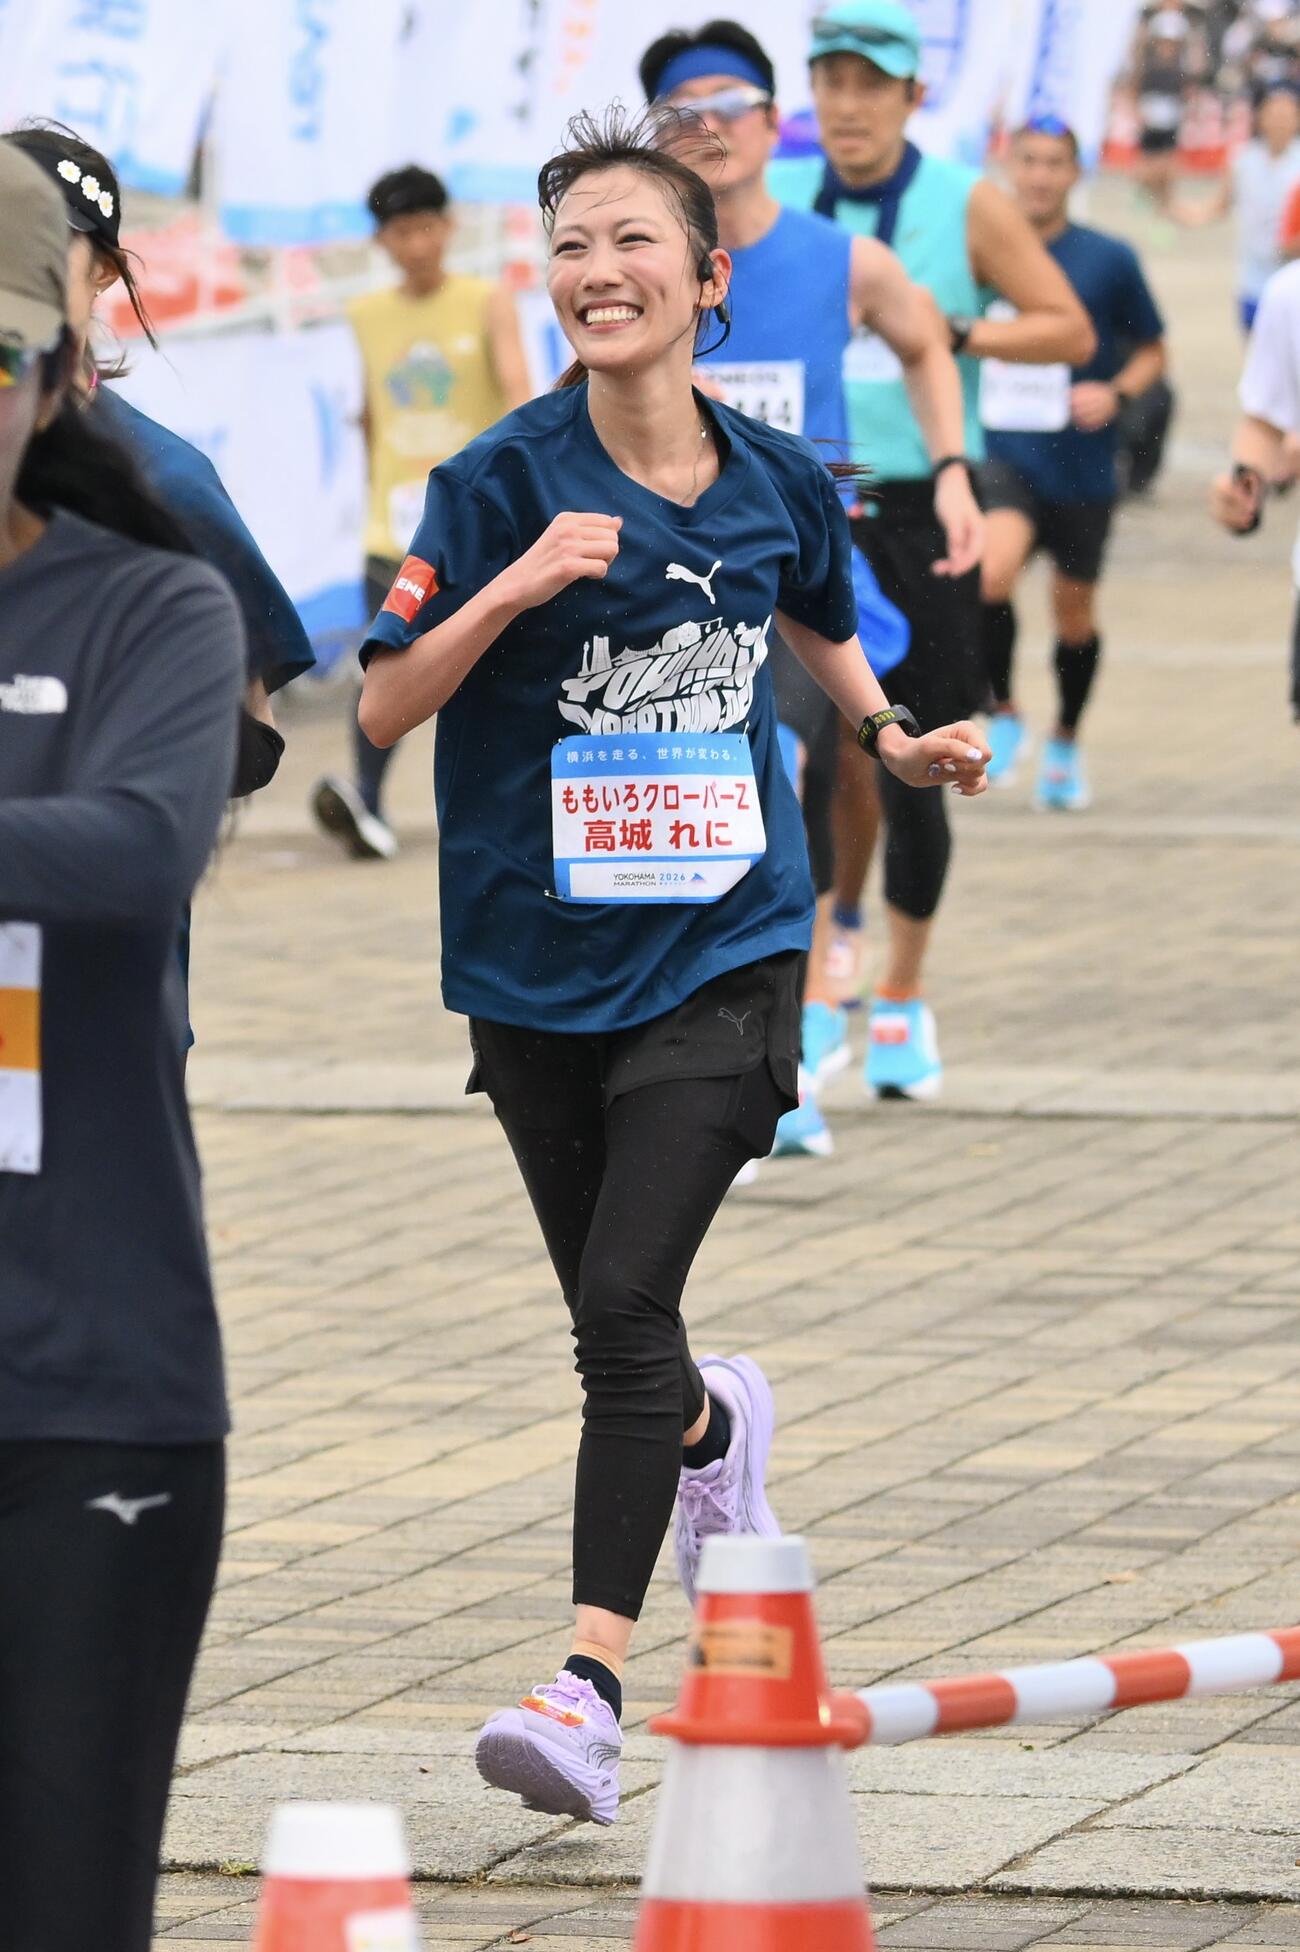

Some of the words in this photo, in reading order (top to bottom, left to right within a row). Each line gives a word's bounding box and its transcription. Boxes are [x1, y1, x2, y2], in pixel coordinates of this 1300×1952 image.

[583, 819, 654, 852] 高城
[669, 820, 733, 849] れに
[613, 873, 656, 881] YOKOHAMA
[659, 873, 686, 881] 2026
